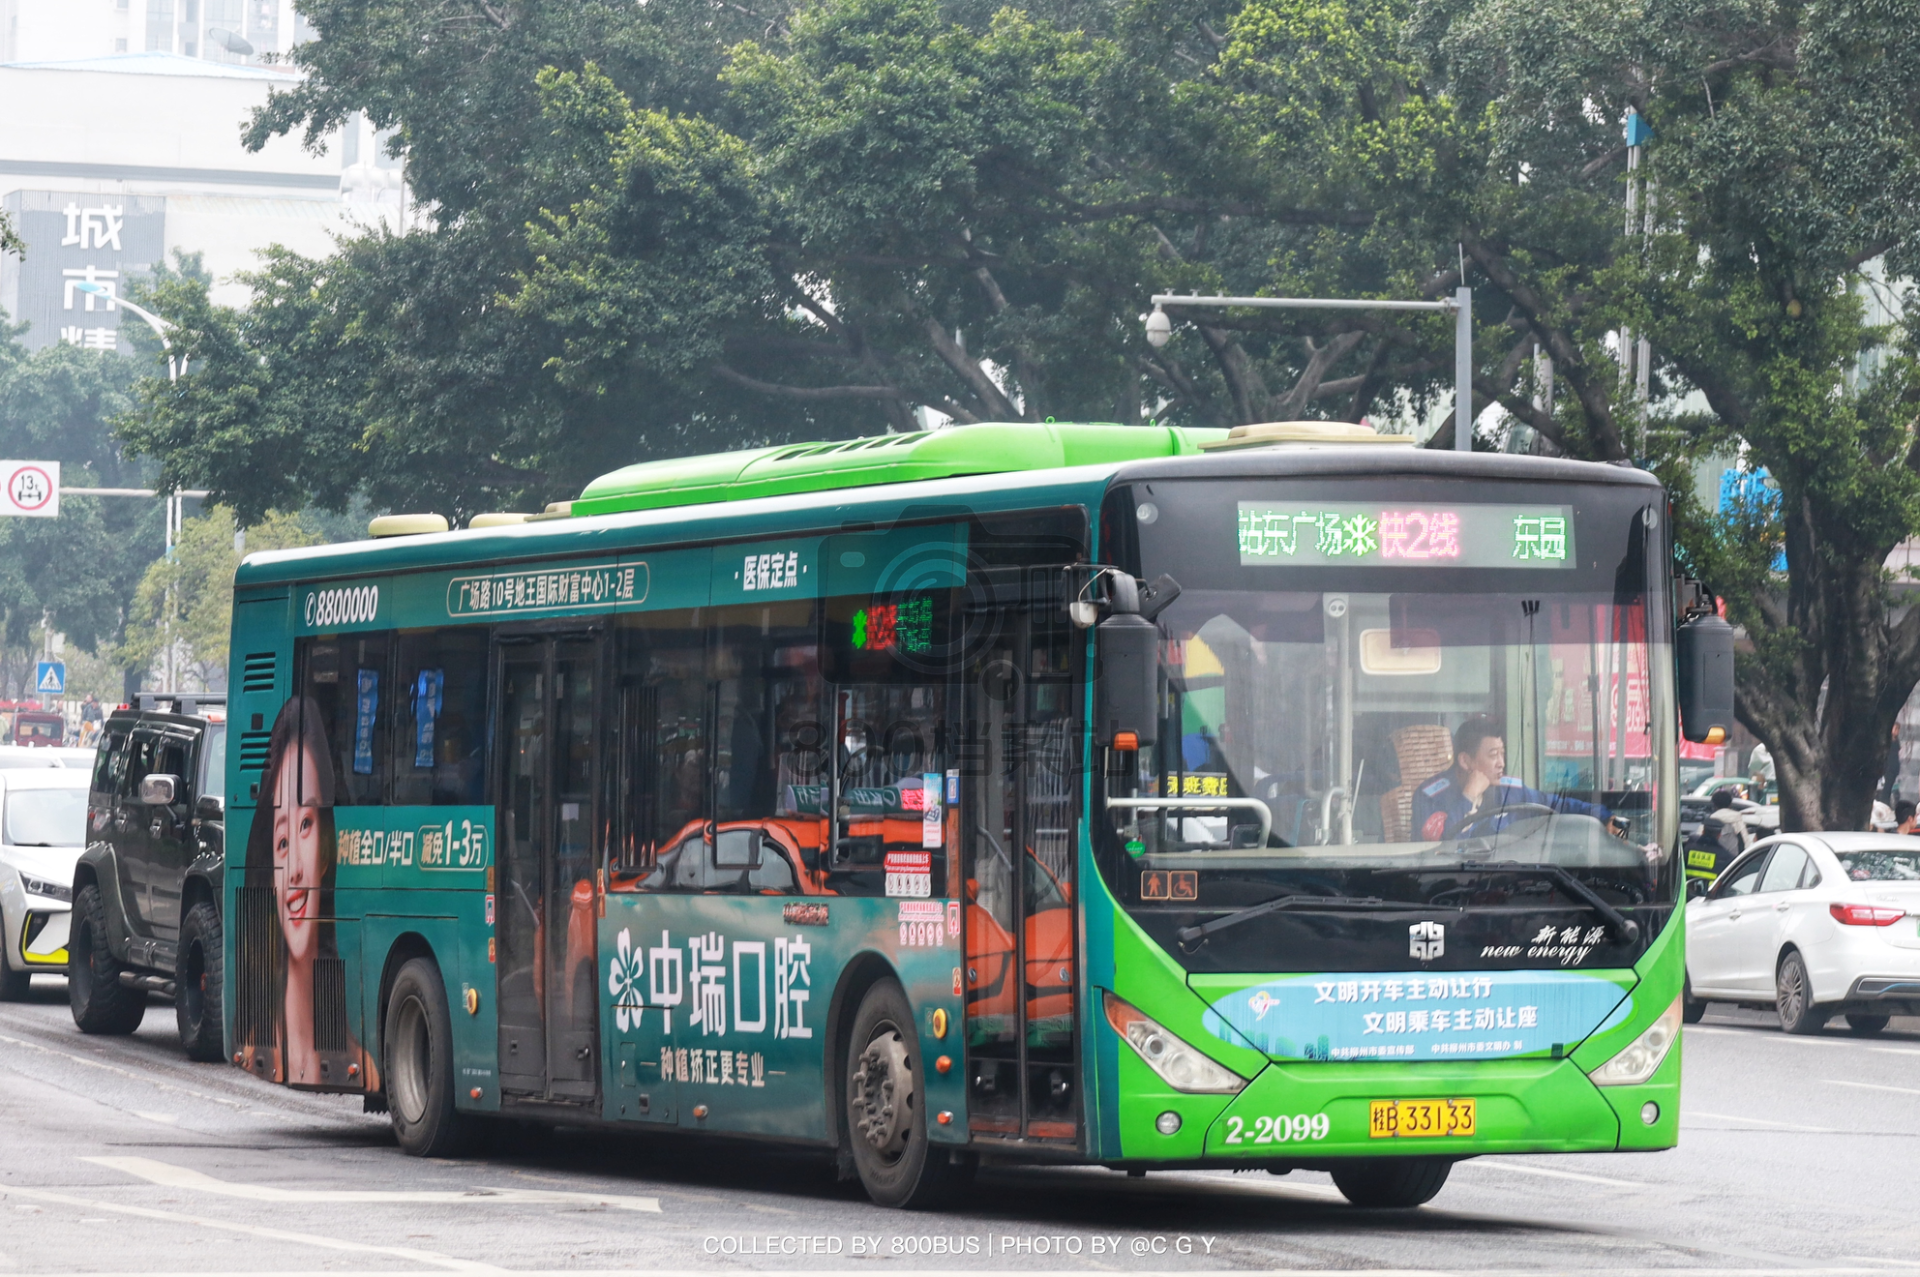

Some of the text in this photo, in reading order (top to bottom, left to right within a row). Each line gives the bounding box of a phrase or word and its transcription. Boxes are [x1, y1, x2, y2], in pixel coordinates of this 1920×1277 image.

[1379, 512, 1460, 557] 快2线
[315, 585, 379, 626] 8800000
[458, 568, 635, 611] 广场路10号地王国际财富中心1-2层
[337, 819, 483, 867] 种植全口/半口 减免1-3万
[1531, 924, 1605, 944] 新能源
[1480, 944, 1593, 966] new energy
[649, 929, 813, 1040] 中瑞口腔
[1314, 977, 1493, 1004] 文明开车主动让行
[1362, 1005, 1538, 1035] 文明乘车主动让座
[660, 1046, 765, 1087] 种植矫正更专业
[1225, 1112, 1330, 1144] 2-2099
